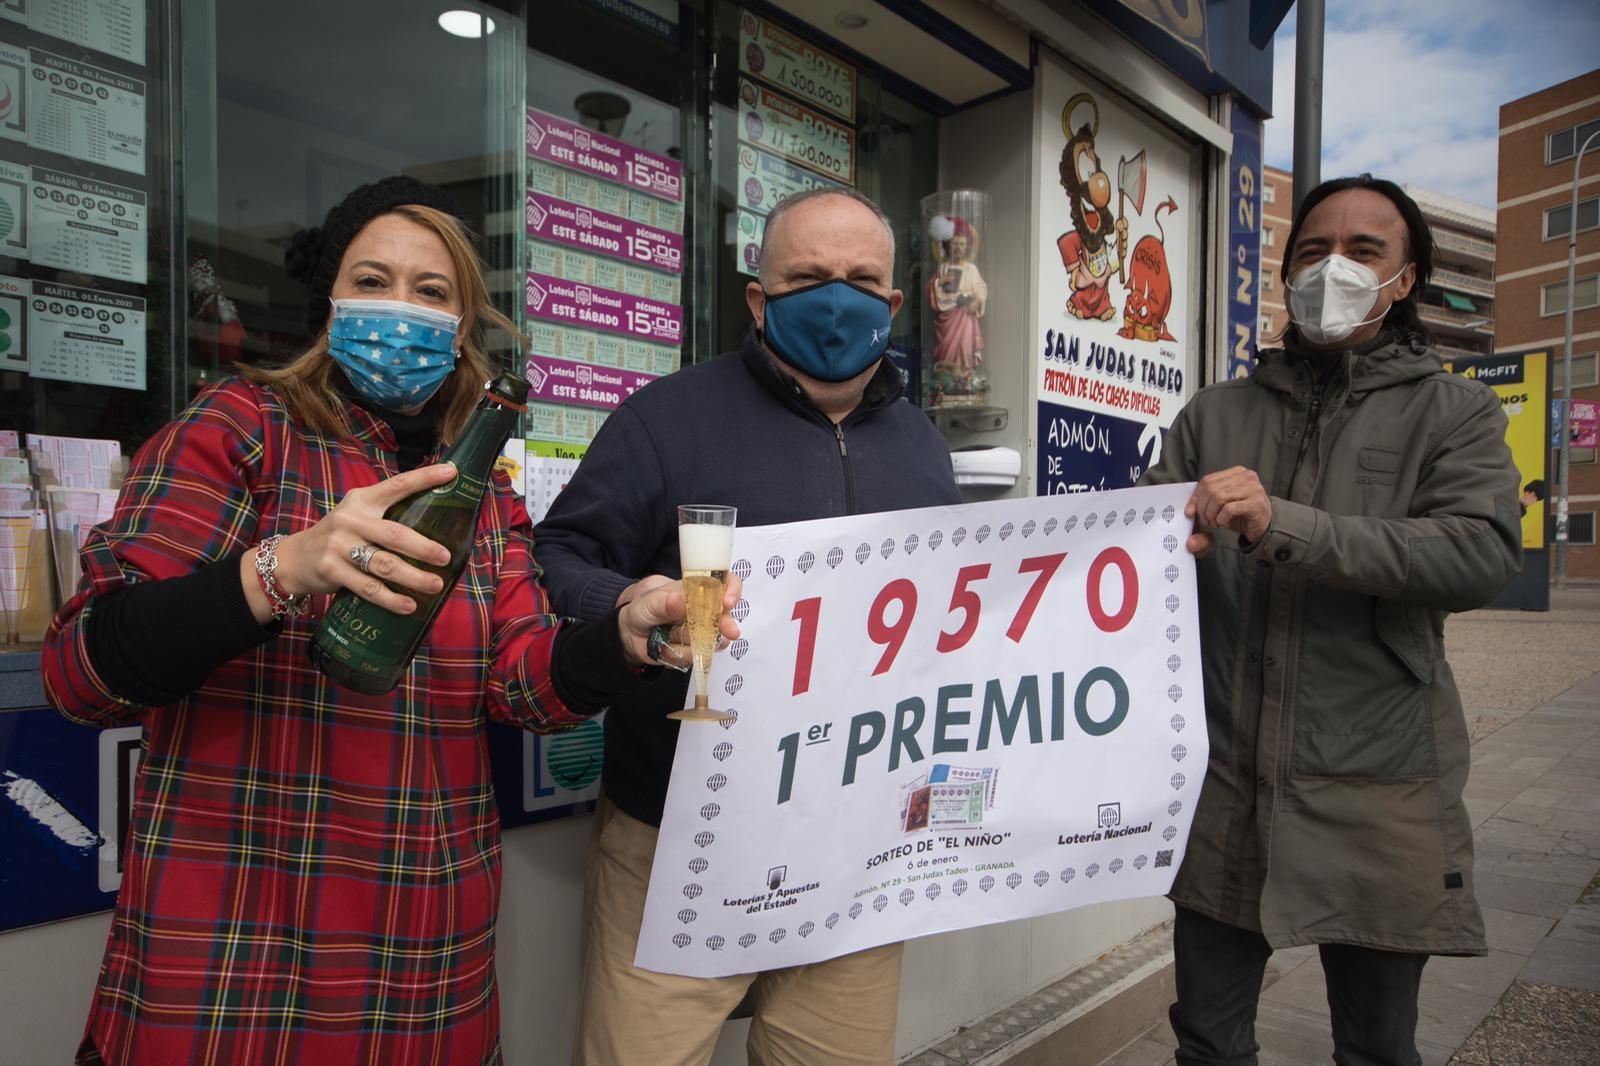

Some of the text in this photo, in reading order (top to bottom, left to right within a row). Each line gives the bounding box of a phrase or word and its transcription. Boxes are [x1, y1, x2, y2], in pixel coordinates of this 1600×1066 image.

[803, 50, 850, 89] BOTE
[802, 112, 850, 152] BOTE
[551, 145, 618, 176] ESTE SÁBADO
[591, 139, 621, 158] Nacional
[635, 152, 664, 171] DÉCIMOS
[1239, 165, 1254, 232] 29
[593, 218, 622, 233] Nacional
[636, 228, 665, 244] DÉCIMOS
[552, 224, 619, 252] ESTE SÁBADO
[592, 293, 622, 308] Nacional
[635, 302, 665, 315] DÉCIMOS
[552, 303, 619, 327] ESTE SÁBADO
[654, 330, 680, 340] EUROS
[1044, 328, 1080, 364] SAN
[1086, 341, 1135, 381] JUDAS
[1141, 358, 1183, 395] TADEO
[1477, 364, 1518, 379] McFIT
[593, 373, 622, 386] Nacional
[1043, 367, 1077, 397] PATRÓN
[1077, 378, 1088, 399] DE
[1089, 380, 1104, 404] LOS
[1105, 385, 1130, 411] CASOS
[552, 384, 577, 398] ESTE
[579, 388, 620, 404] SÁBADO
[1500, 393, 1528, 405] NOS
[1048, 415, 1112, 456] ADMÓN.
[1048, 455, 1063, 475] DE
[334, 604, 381, 641] UBOIS
[790, 545, 1140, 697] 19570
[840, 665, 1130, 788] PREMIO
[1057, 821, 1153, 845] Lotería Nacional
[866, 843, 913, 870] SORTEO
[917, 839, 934, 853] DE
[907, 855, 959, 870] 6 de enero
[892, 878, 901, 887] 29
[907, 874, 921, 884] San
[922, 871, 943, 880] Judas
[945, 866, 969, 876] Tadeo
[975, 861, 1015, 872] GRANADA
[723, 881, 820, 907] Loterías y Apuestas
[746, 897, 798, 915] del Estado
